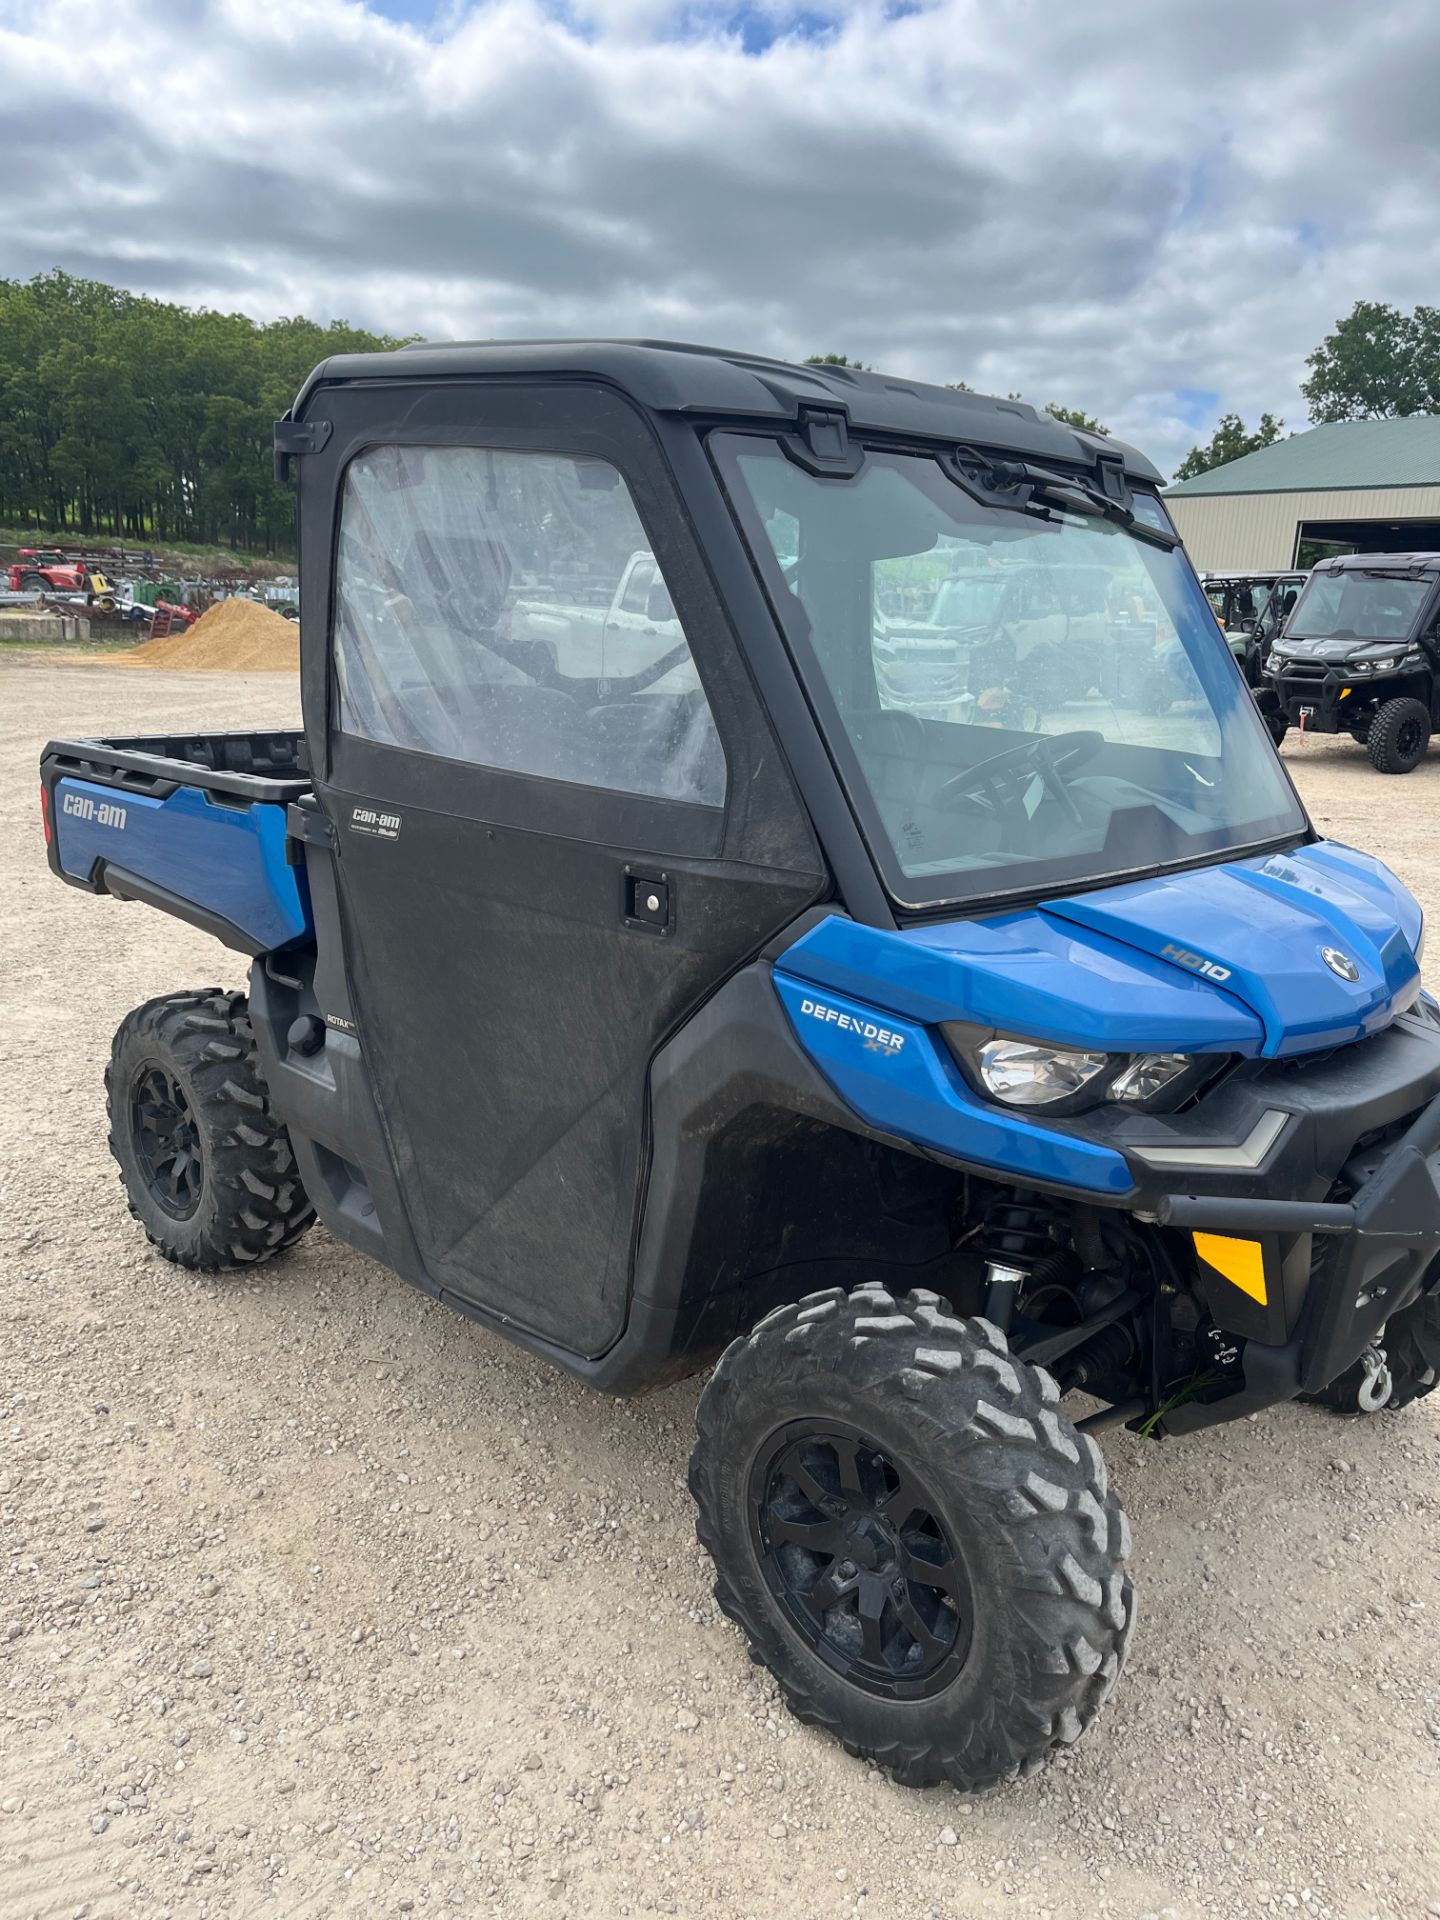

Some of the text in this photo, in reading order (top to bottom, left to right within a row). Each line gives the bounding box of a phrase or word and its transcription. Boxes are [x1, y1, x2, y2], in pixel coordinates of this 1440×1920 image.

[63, 793, 127, 830] can-am
[352, 808, 400, 829] can-am
[1160, 943, 1232, 982] HD10
[327, 1013, 349, 1029] ROTAX
[800, 999, 905, 1050] DEFENDER
[863, 1039, 901, 1057] XT
